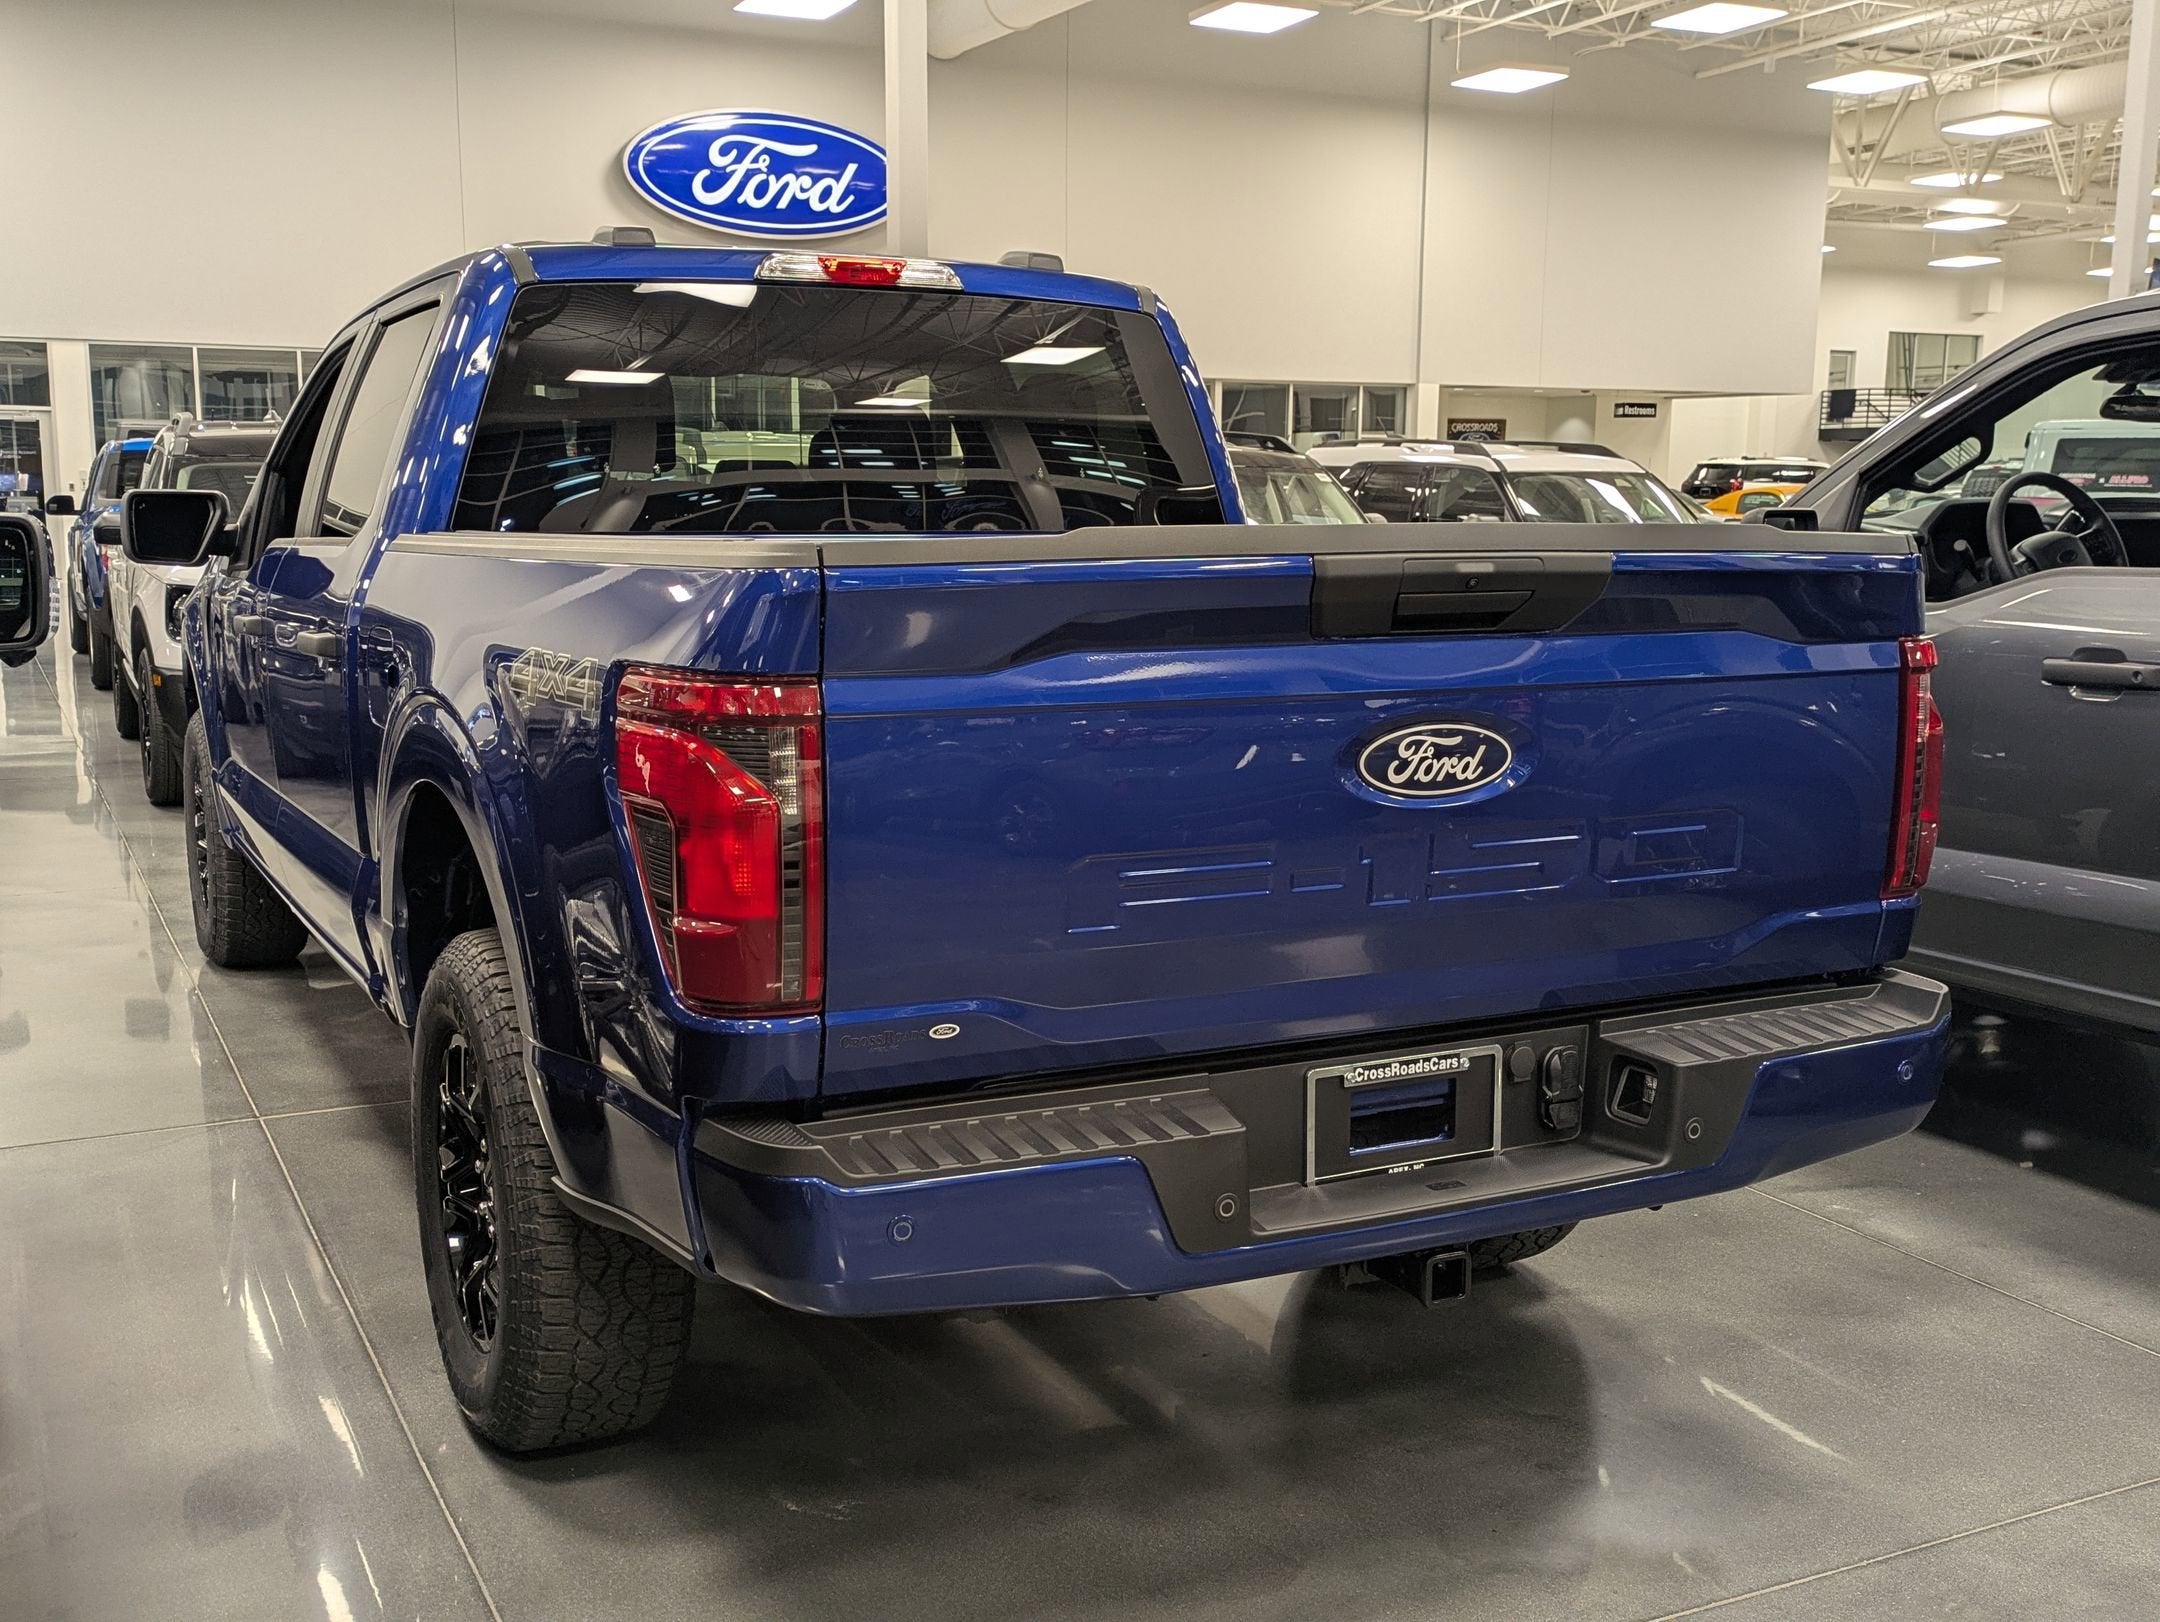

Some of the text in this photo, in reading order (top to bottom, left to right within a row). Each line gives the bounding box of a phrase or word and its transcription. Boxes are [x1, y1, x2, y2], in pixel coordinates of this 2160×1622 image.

[691, 134, 859, 214] Ford
[1451, 422, 1498, 433] CROSSROADS
[1624, 405, 1655, 415] Restrooms
[510, 646, 598, 721] 4X4
[1387, 735, 1486, 784] Ford
[1355, 1057, 1459, 1082] CrossRoadsCars
